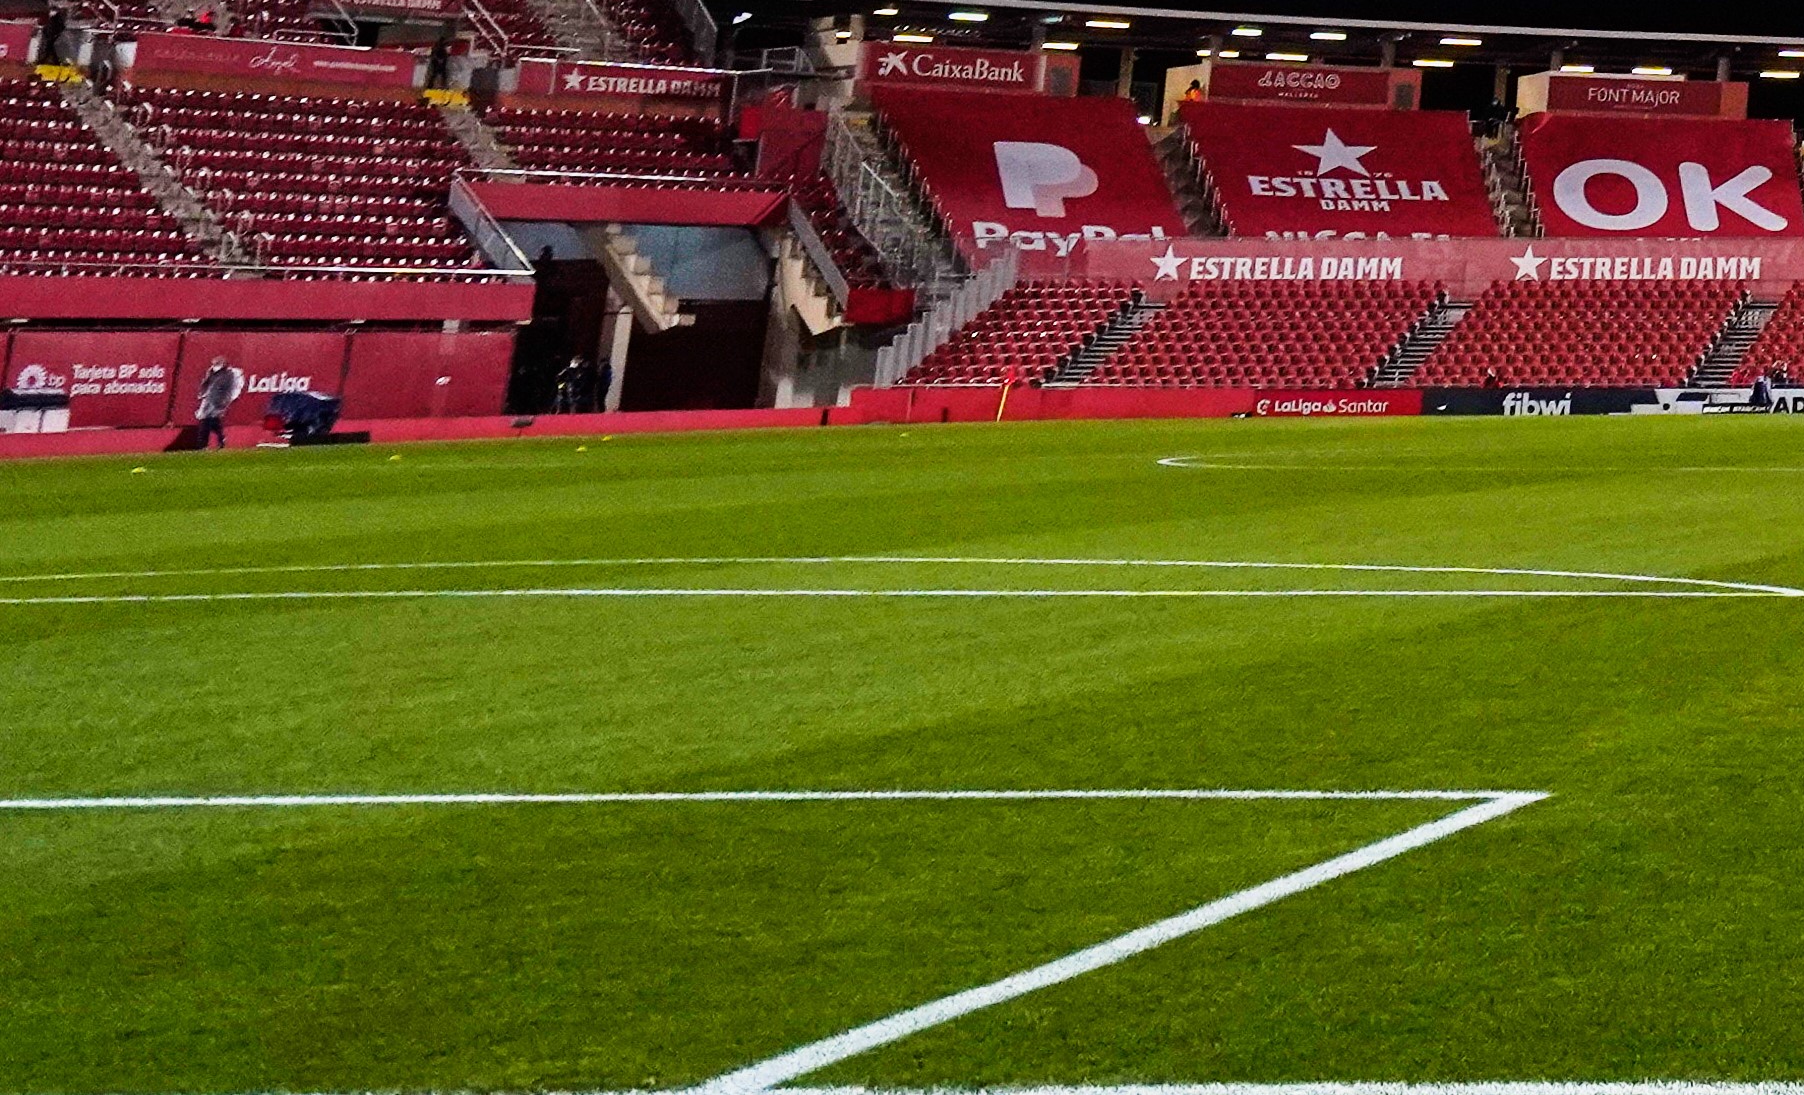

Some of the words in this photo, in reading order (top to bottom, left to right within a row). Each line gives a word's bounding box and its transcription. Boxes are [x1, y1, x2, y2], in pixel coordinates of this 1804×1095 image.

[911, 54, 1025, 82] CaixaBank
[586, 75, 668, 95] ESTRELLA
[669, 81, 721, 97] DAMM
[1588, 87, 1632, 103] FONT
[1247, 174, 1450, 201] ESTRELLA
[1552, 158, 1789, 232] OK
[1320, 199, 1391, 212] DAMM
[1189, 256, 1315, 280] ESTRELLA
[1319, 257, 1403, 280] DAMM
[1550, 256, 1674, 281] ESTRELLA
[1680, 257, 1762, 281] DAMM
[72, 363, 117, 381] Tarjeta
[118, 364, 138, 378] BP
[247, 372, 311, 392] LaLiga
[70, 382, 102, 397] para
[103, 380, 166, 394] abonados
[1274, 398, 1322, 415] LaLiga
[1338, 398, 1389, 413] Santar
[1502, 392, 1573, 416] fibwi
